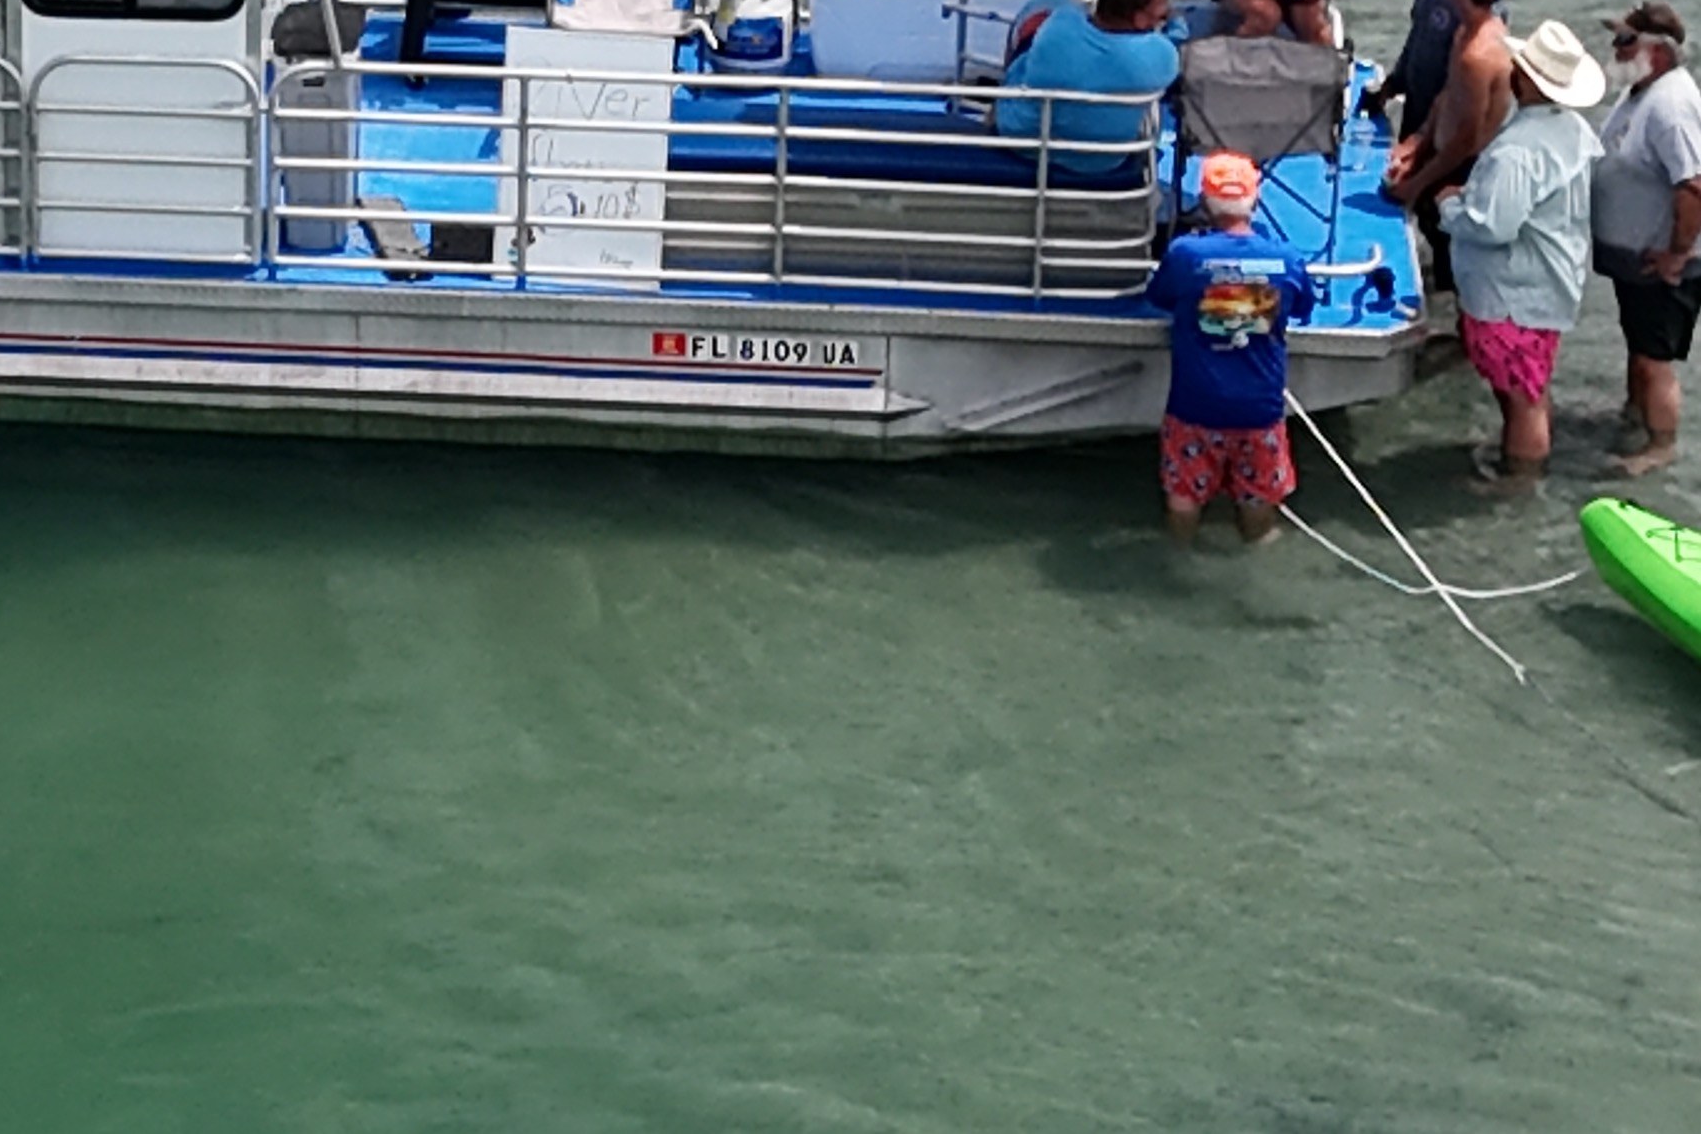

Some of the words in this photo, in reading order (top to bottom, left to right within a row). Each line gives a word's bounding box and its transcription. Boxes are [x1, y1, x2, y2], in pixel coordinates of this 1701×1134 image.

[691, 336, 727, 359] FL
[739, 339, 808, 363] 8109
[823, 343, 856, 365] UA
